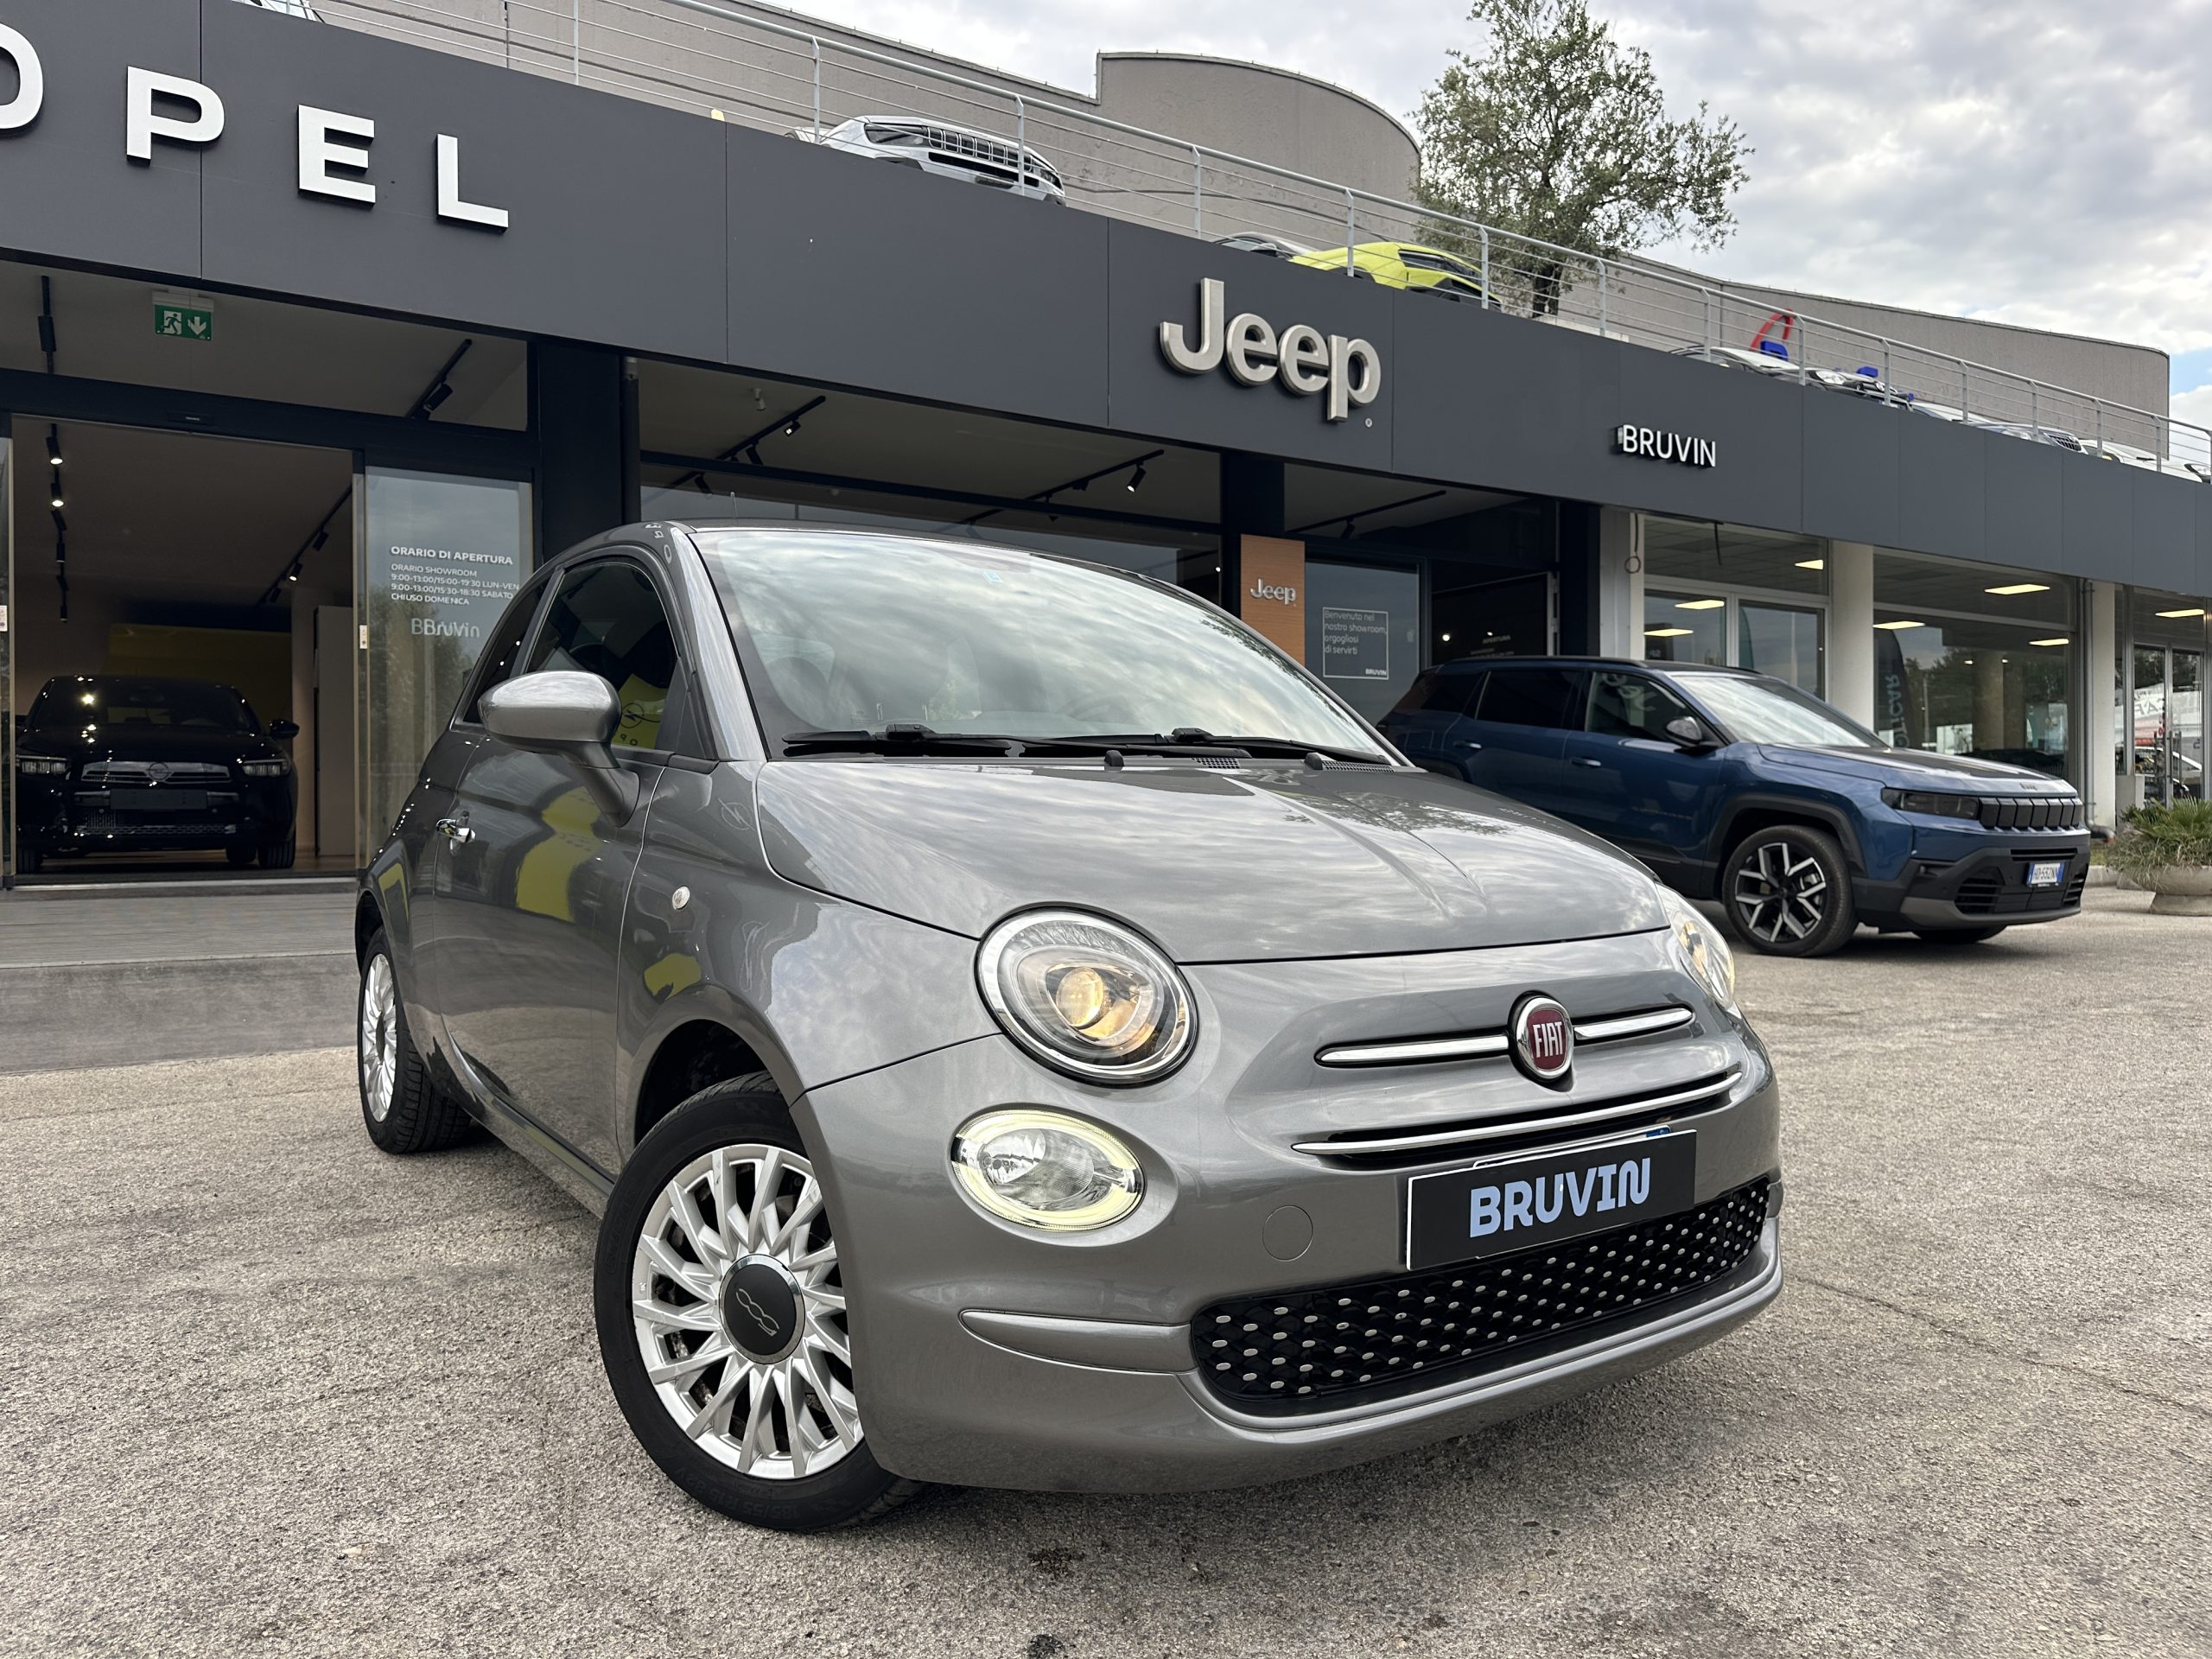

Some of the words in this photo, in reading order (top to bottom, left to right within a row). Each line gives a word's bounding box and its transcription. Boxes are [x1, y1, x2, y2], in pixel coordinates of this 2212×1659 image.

[1159, 277, 1382, 421] Jeep
[1621, 423, 1716, 467] BRUVIN
[390, 546, 436, 558] ORARIO
[438, 550, 451, 560] DI
[453, 551, 513, 565] APERTURA
[391, 563, 423, 574] ORARIO
[425, 566, 477, 577] SHOWROOM
[391, 593, 423, 603] CHIUSO
[424, 594, 469, 605] DOMENICA
[481, 589, 514, 601] SABATO
[1249, 578, 1296, 605] Jeep
[1325, 610, 1363, 621] Benvenuto
[1363, 613, 1375, 622] nel
[1325, 622, 1348, 632] nostro
[1325, 633, 1359, 645] orgogliosi
[1532, 1021, 1563, 1058] FIAT
[1469, 1157, 1651, 1238] BRUVIN
